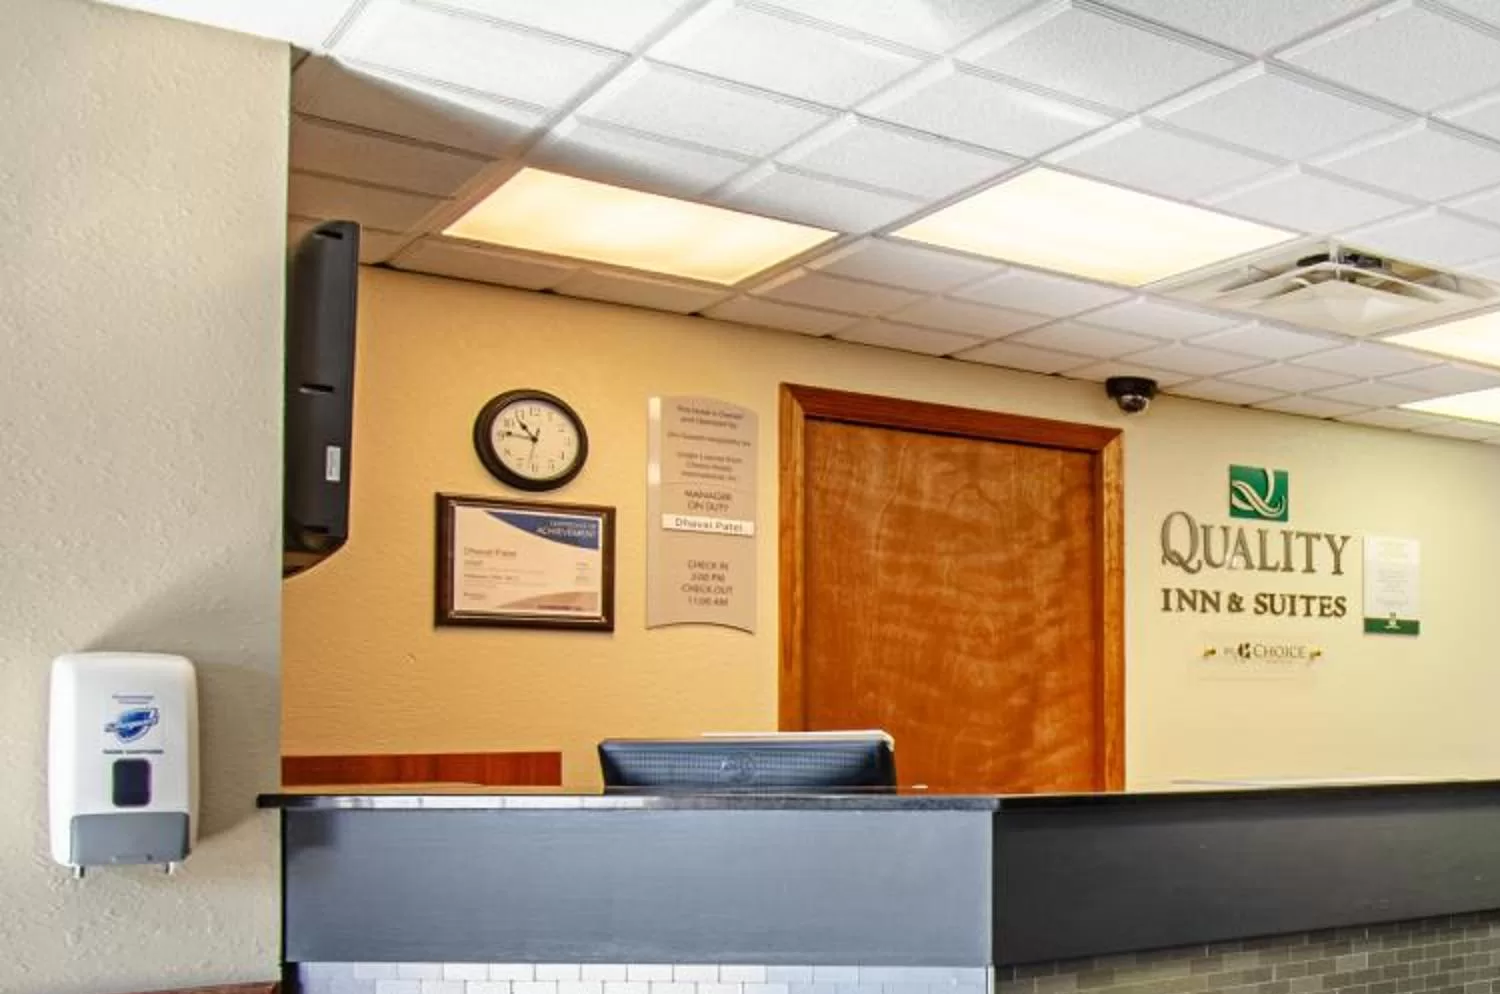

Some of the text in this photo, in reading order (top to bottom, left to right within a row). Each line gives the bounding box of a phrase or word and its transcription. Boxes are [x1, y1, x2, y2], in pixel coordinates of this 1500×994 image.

[684, 489, 732, 501] MANAGER
[687, 500, 730, 512] ON DUTY
[675, 517, 743, 532] Dhaval Patel
[1160, 511, 1352, 575] QUALITY
[1161, 588, 1347, 617] INN & SUITES
[1253, 643, 1308, 658] CHOICE
